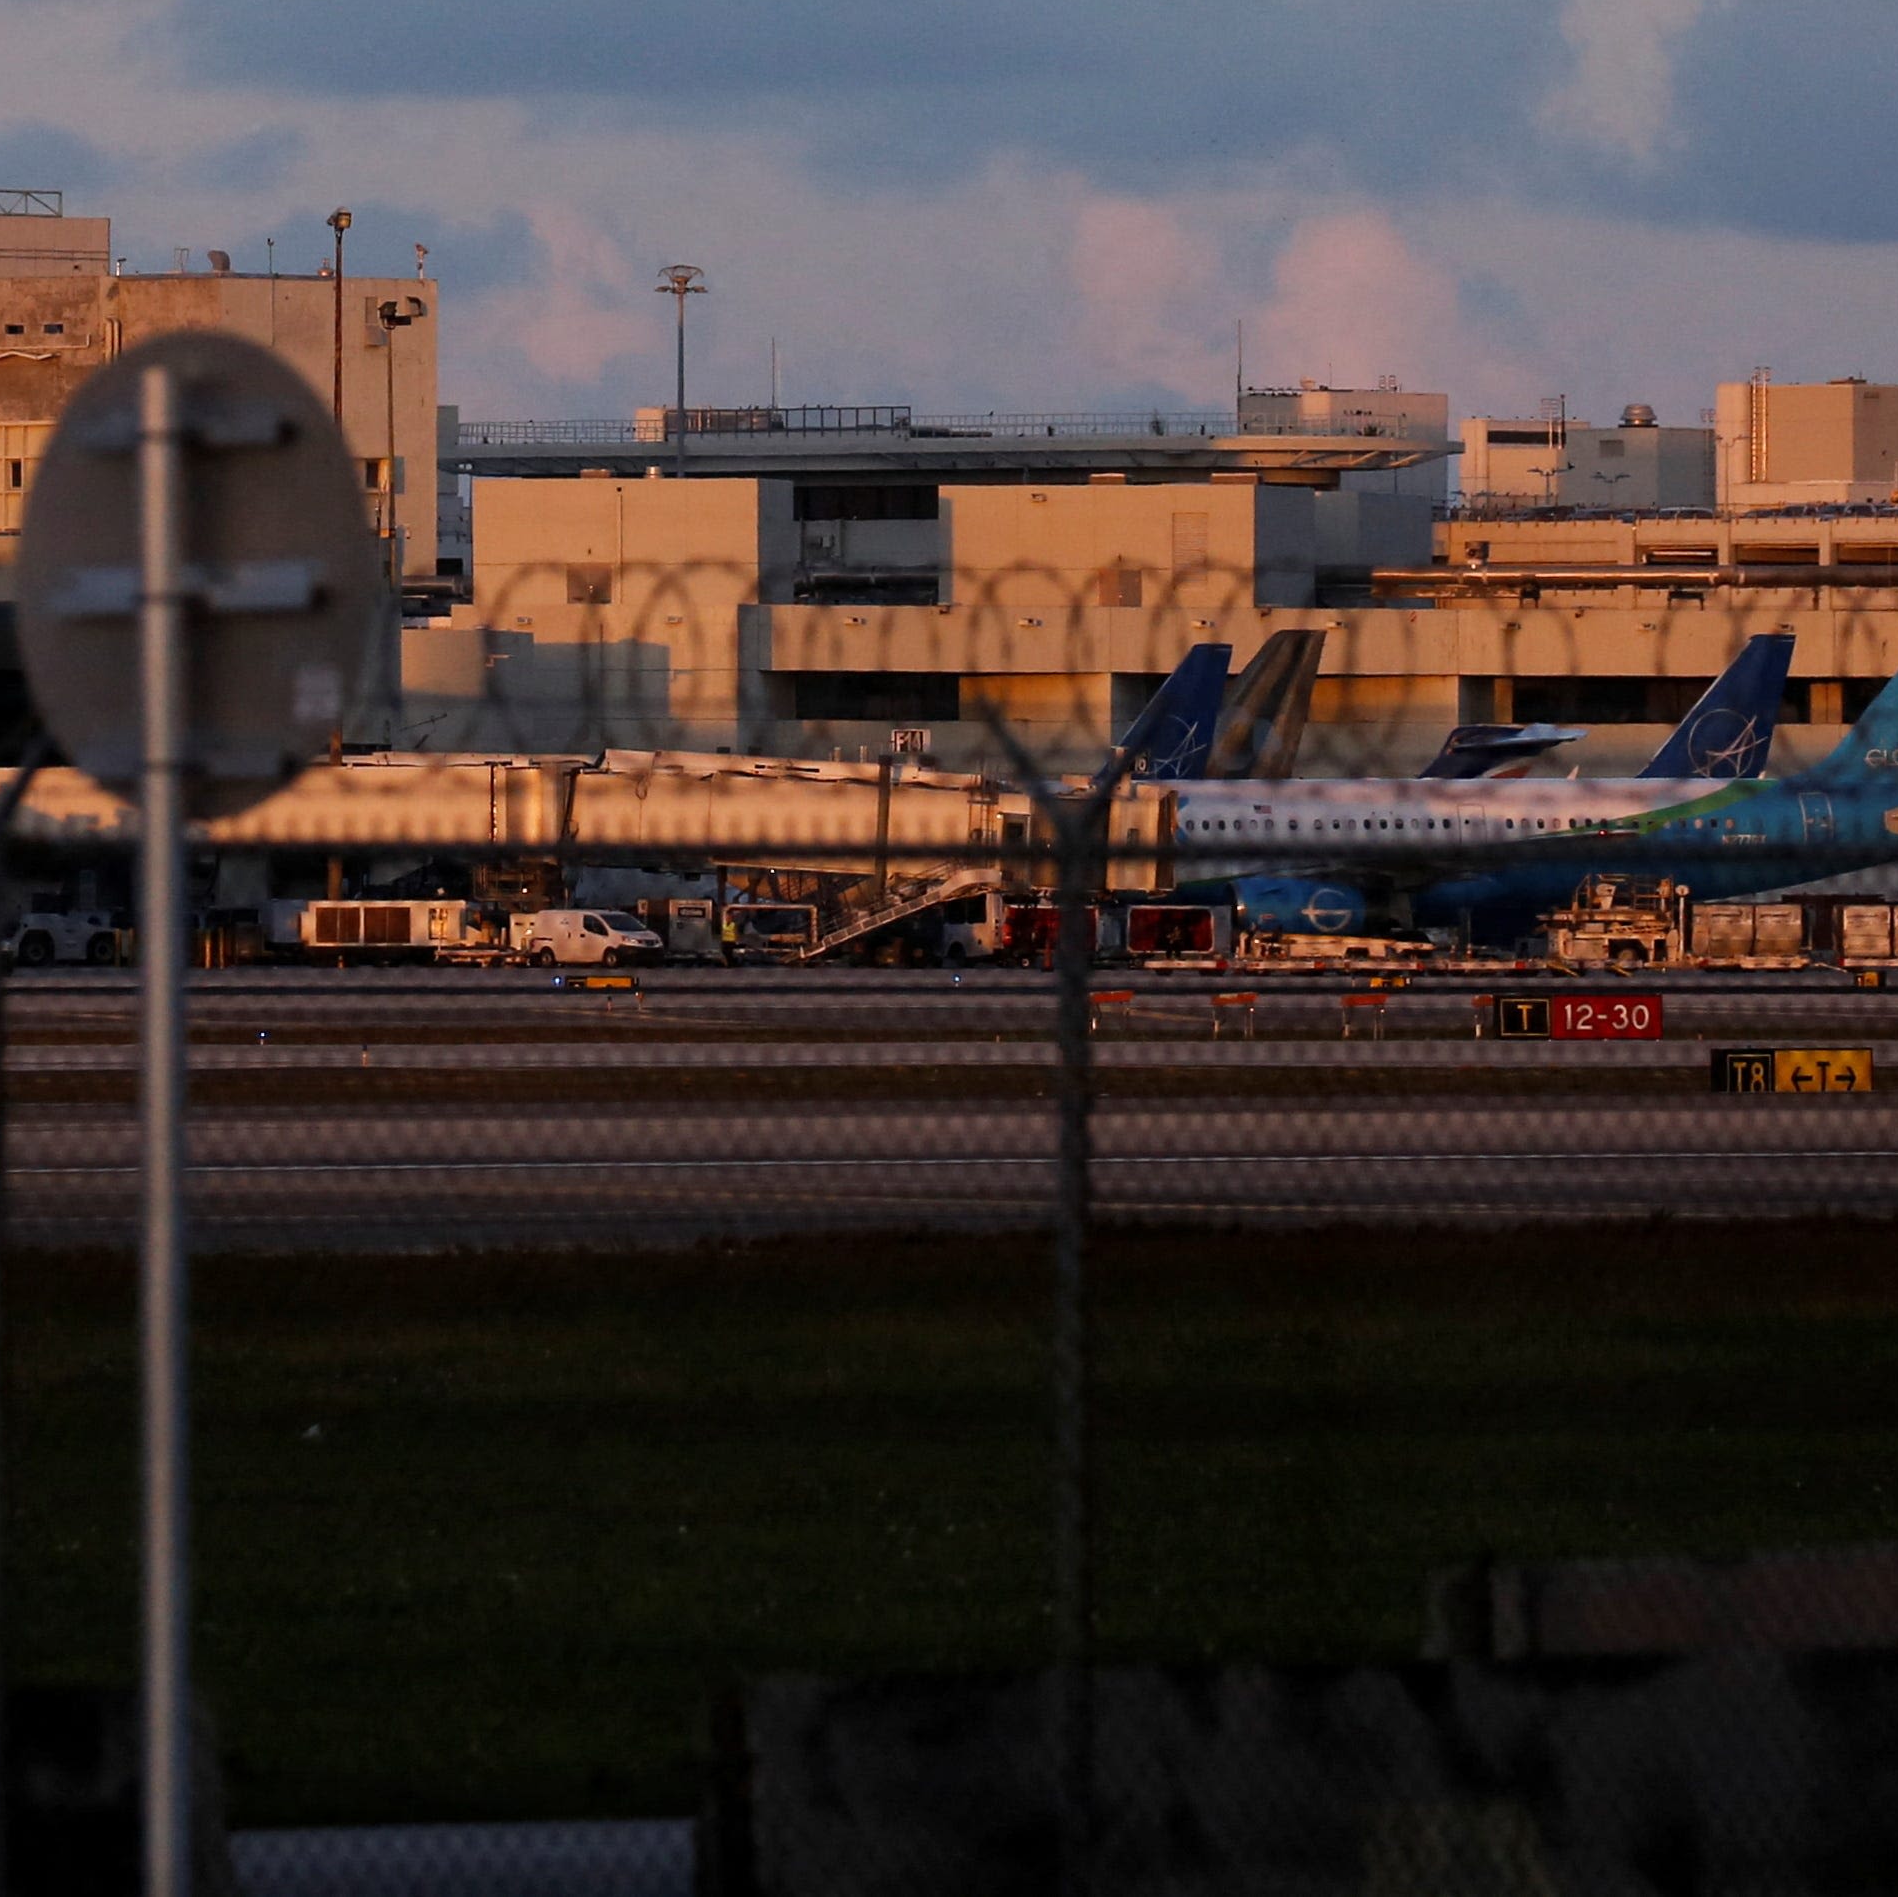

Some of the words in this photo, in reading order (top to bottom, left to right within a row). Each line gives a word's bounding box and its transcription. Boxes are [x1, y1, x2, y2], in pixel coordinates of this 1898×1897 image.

[1516, 1004, 1534, 1031] T
[1564, 1003, 1650, 1031] 12-30
[1733, 1062, 1765, 1092] T8
[1817, 1061, 1831, 1092] T
